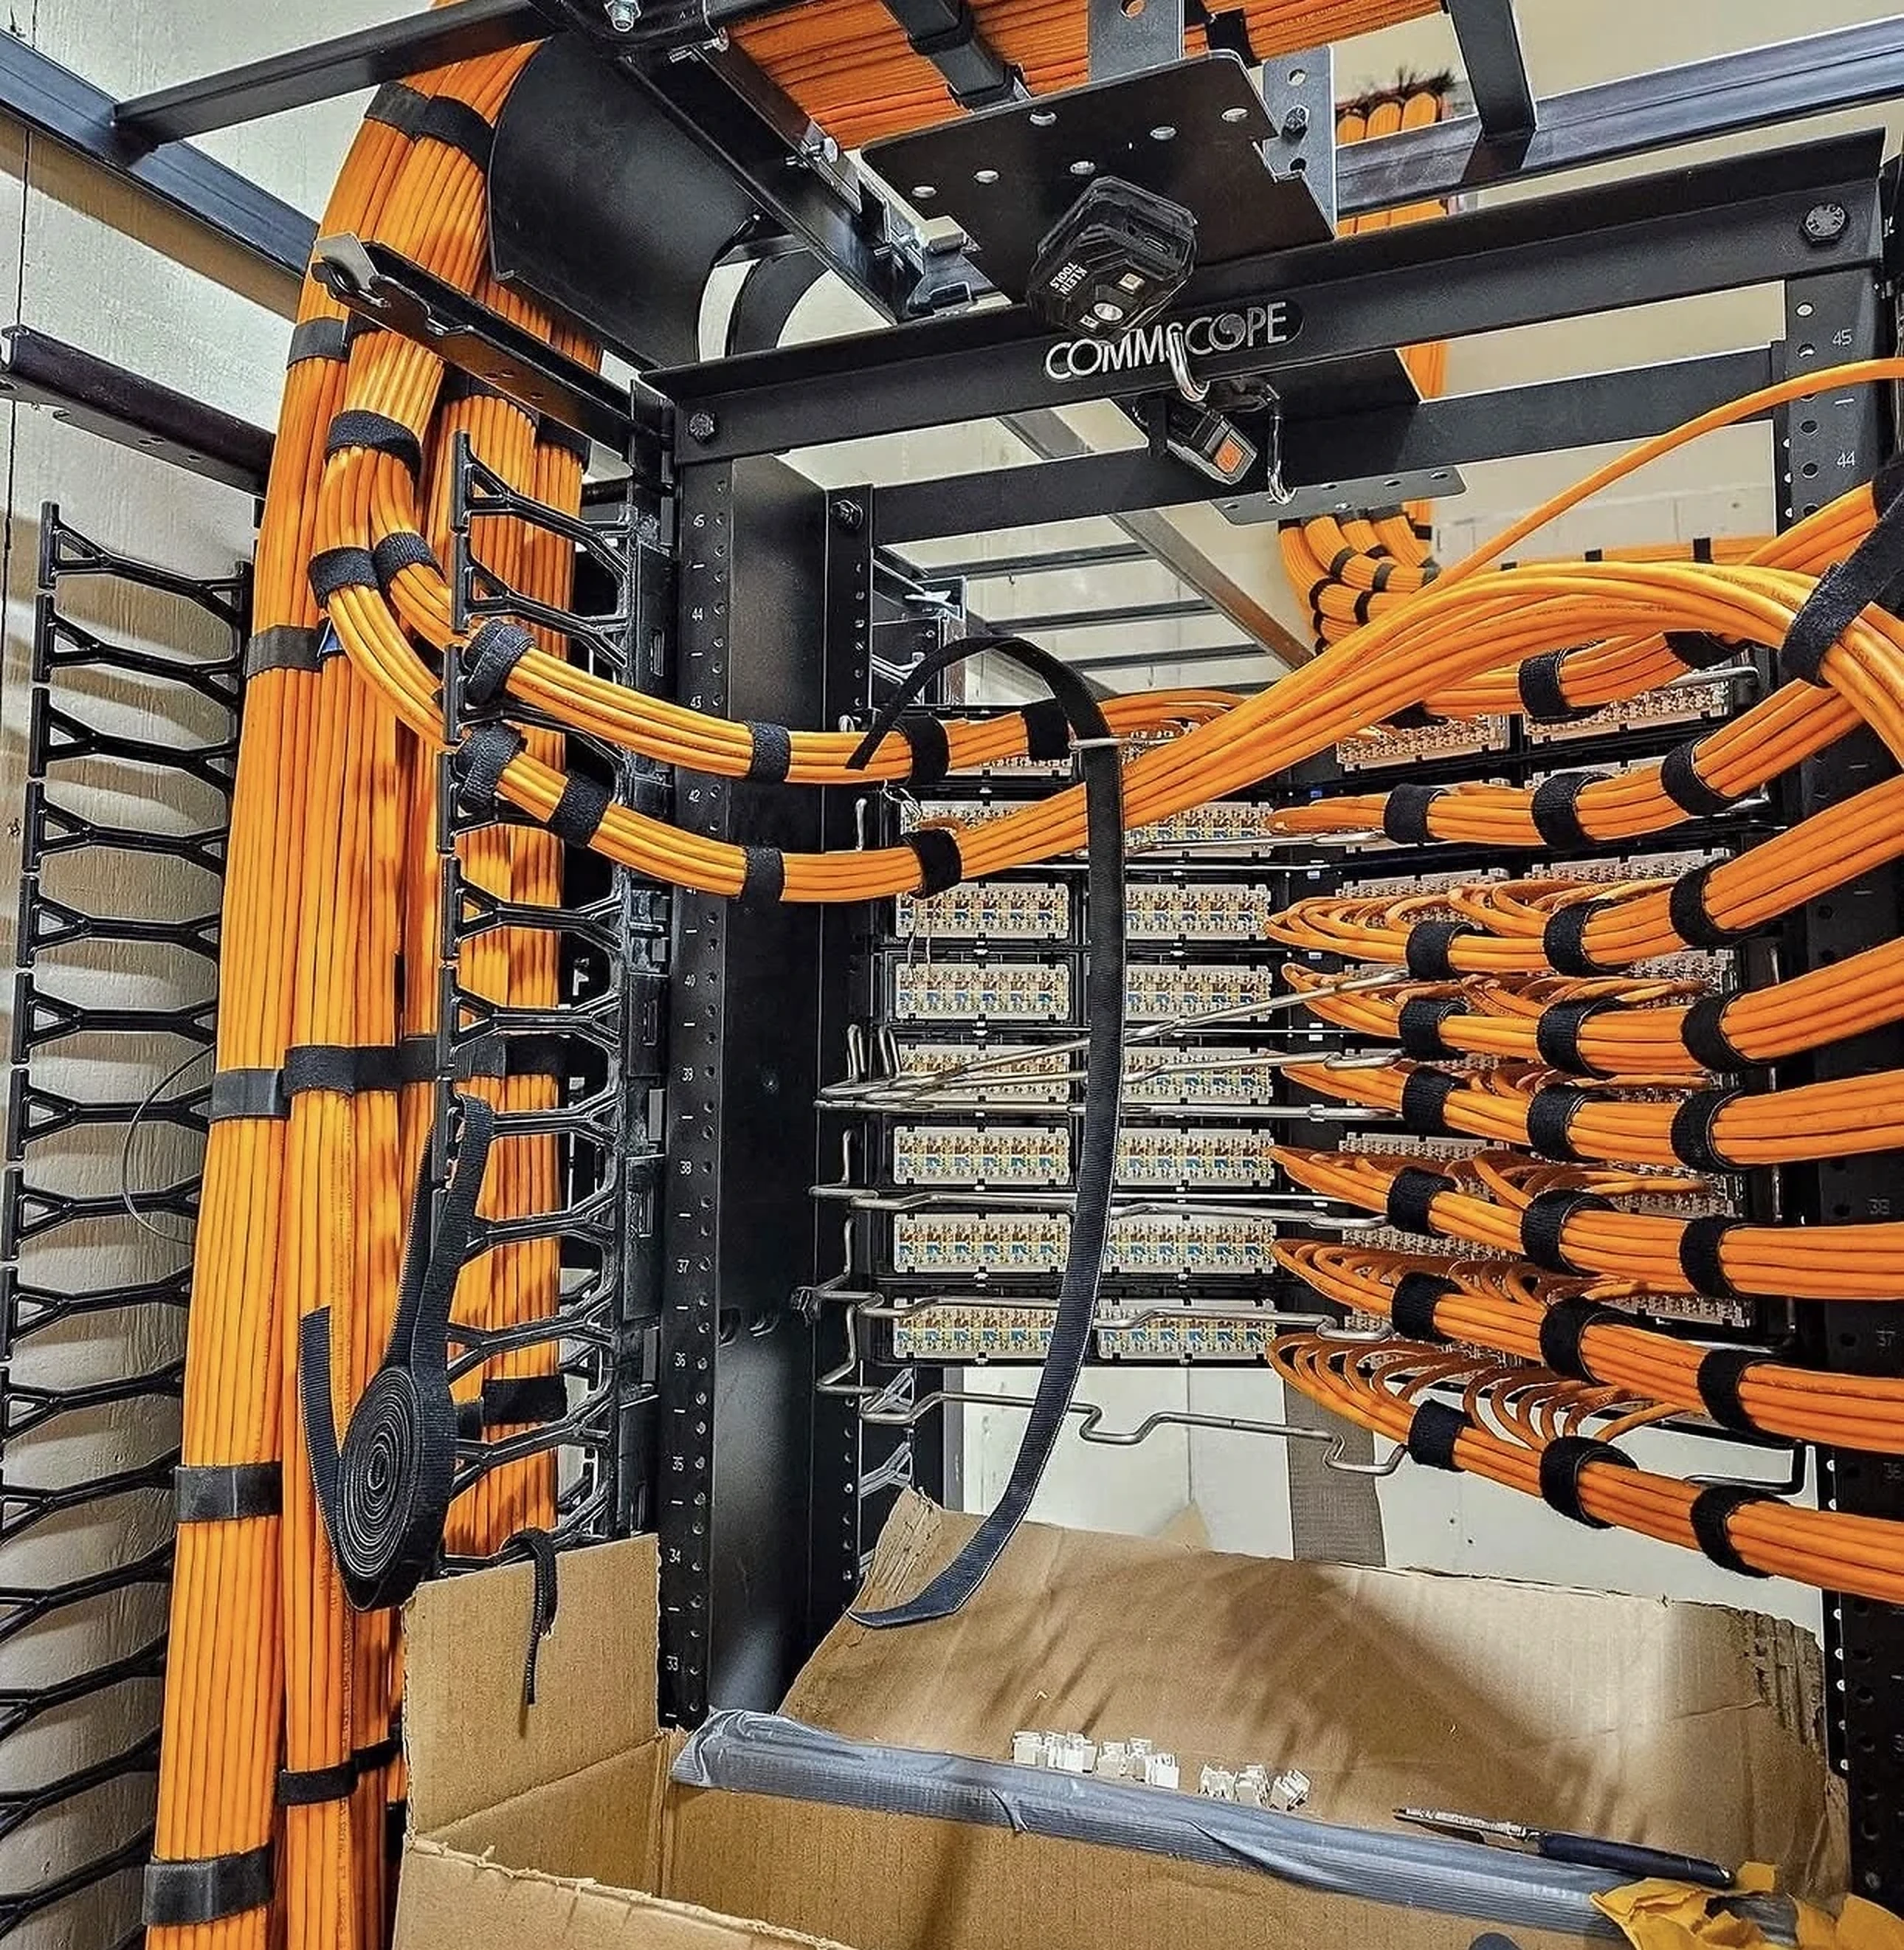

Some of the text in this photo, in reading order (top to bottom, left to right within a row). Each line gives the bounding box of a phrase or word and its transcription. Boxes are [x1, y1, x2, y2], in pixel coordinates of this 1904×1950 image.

[1049, 261, 1078, 290] TOOLS
[1060, 266, 1088, 295] KLEIN
[1832, 328, 1853, 346] 45
[1837, 450, 1856, 469] 44
[693, 514, 706, 528] 45
[691, 607, 704, 622] 44
[690, 695, 703, 709] 43
[688, 789, 701, 803] 42
[684, 974, 697, 988] 40
[682, 1067, 694, 1082] 39
[679, 1160, 692, 1175] 38
[677, 1258, 691, 1273] 37
[675, 1351, 686, 1367] 36
[672, 1455, 685, 1472] 35
[669, 1548, 682, 1564] 34
[666, 1655, 679, 1672] 33
